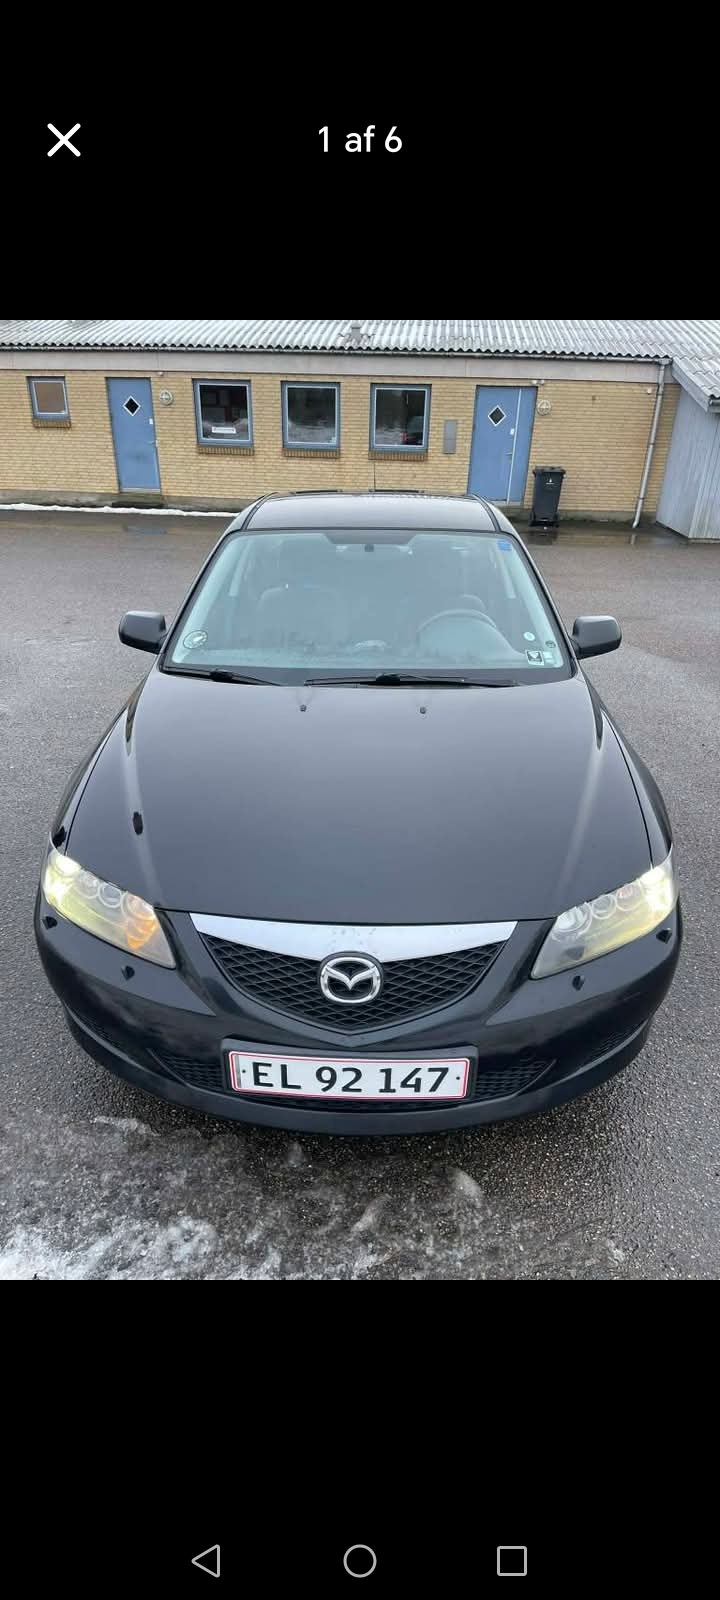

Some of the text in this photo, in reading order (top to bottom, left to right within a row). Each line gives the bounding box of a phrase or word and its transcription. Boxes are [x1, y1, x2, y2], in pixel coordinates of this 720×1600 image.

[252, 1061, 450, 1094] EL 92 147
